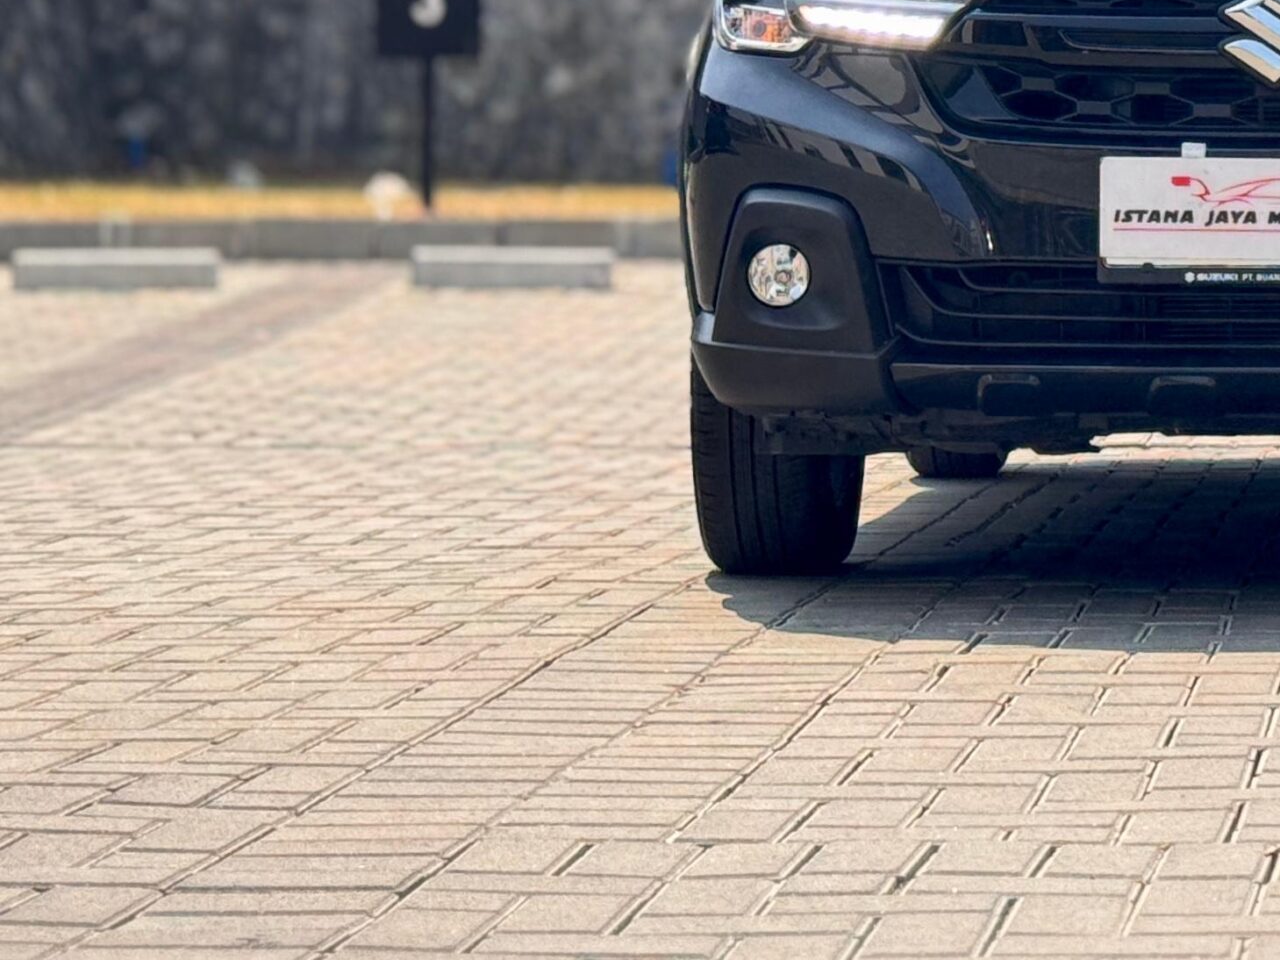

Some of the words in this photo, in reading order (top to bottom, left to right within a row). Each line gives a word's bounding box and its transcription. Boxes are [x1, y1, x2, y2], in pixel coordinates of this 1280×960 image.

[1113, 209, 1194, 224] ISTANA
[1204, 210, 1258, 227] JAYA
[1196, 272, 1238, 282] SUZUKI
